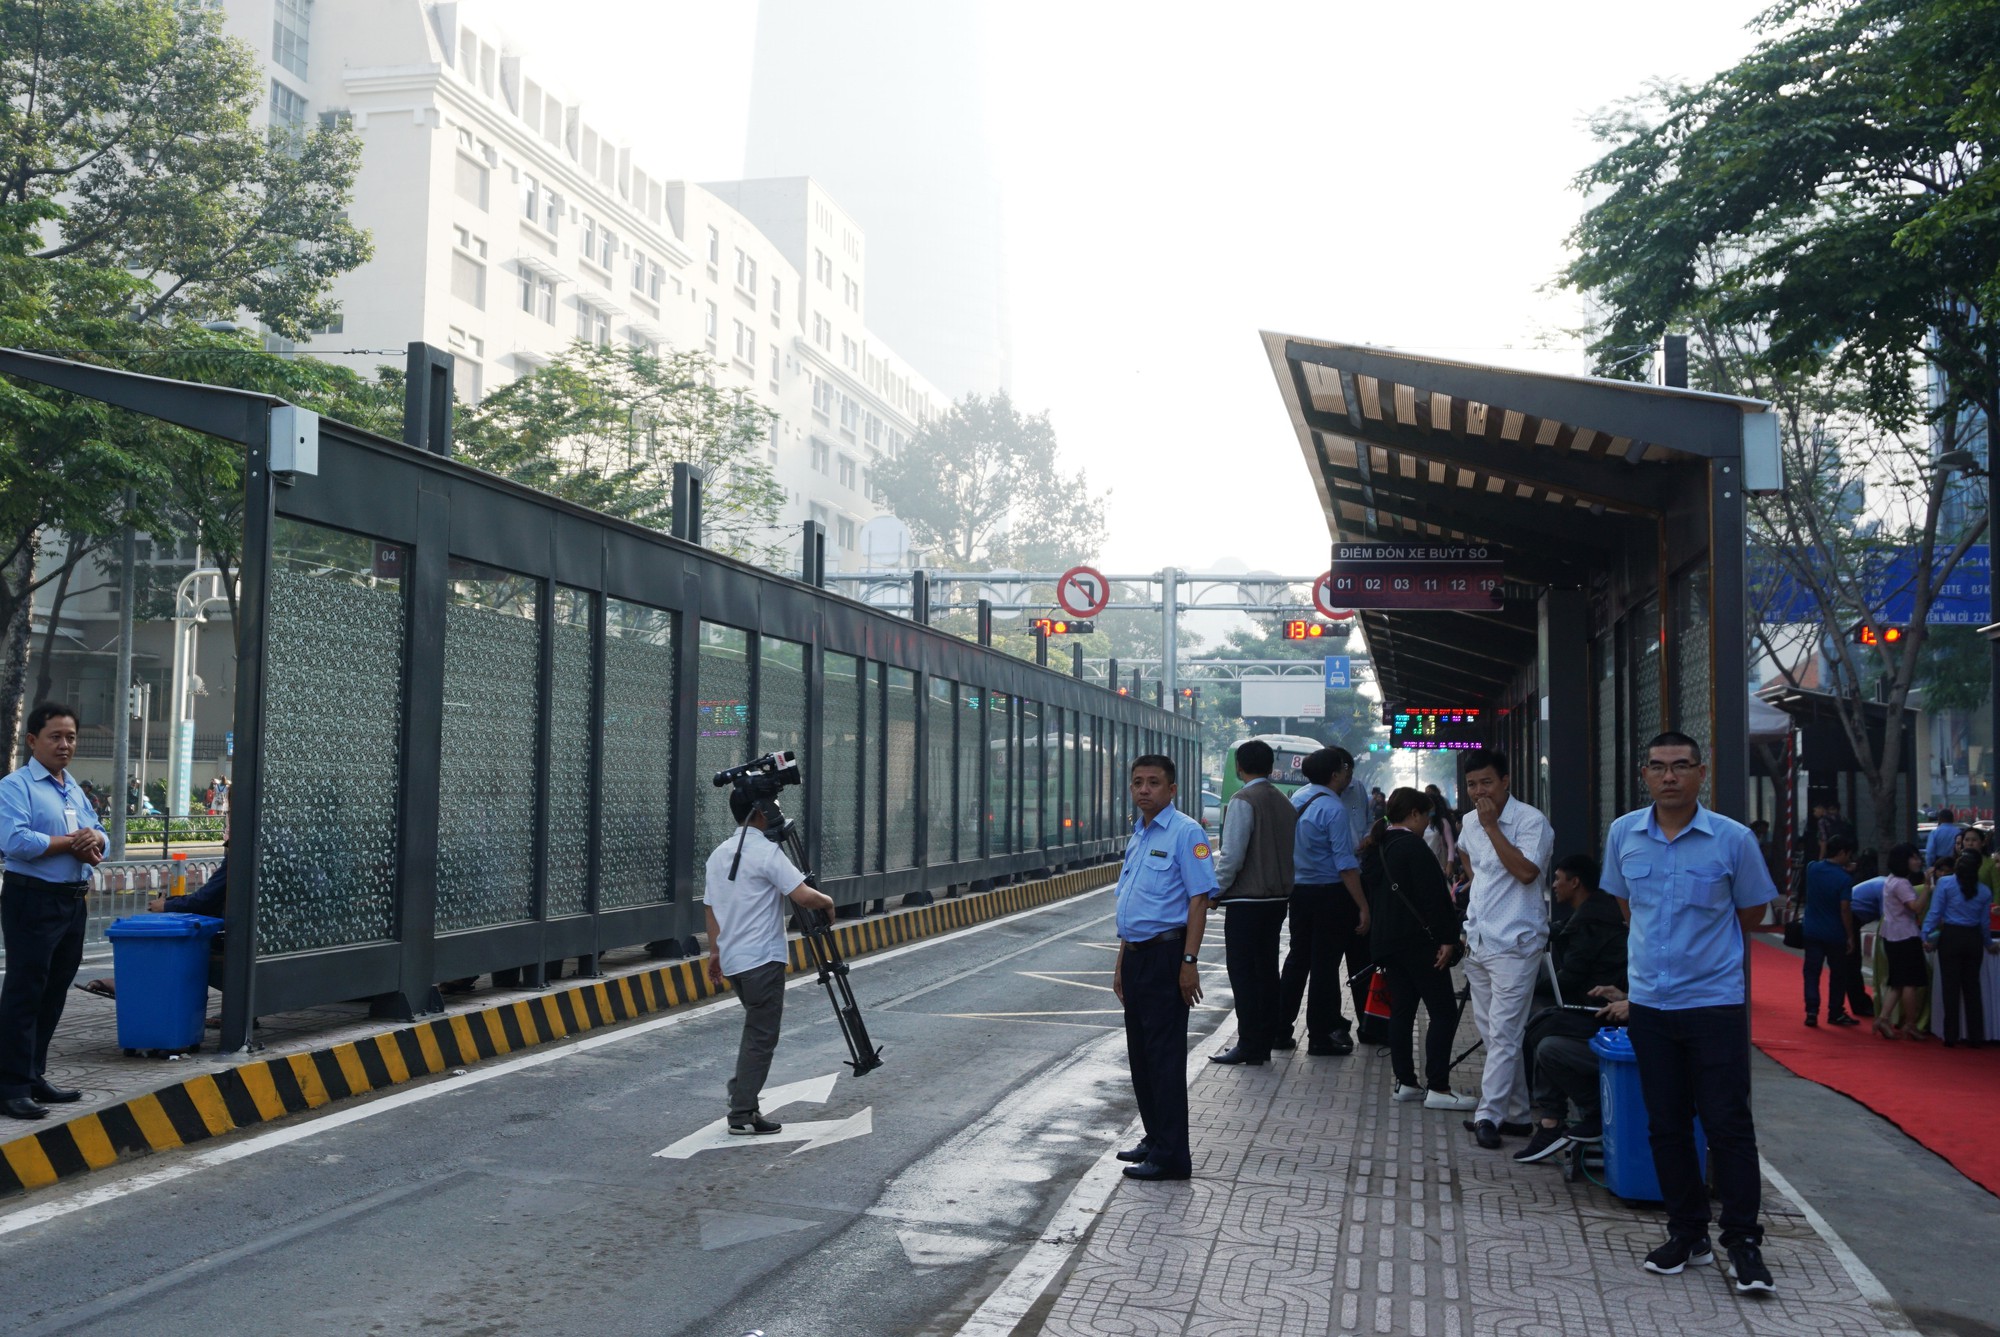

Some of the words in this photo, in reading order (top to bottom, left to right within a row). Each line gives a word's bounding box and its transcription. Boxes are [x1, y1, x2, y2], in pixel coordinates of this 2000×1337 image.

[381, 550, 396, 562] 04
[1408, 548, 1426, 559] XE
[1429, 545, 1465, 559] BUÝT
[1337, 578, 1351, 589] 01
[1365, 578, 1381, 590] 02
[1394, 578, 1410, 590] 03
[1424, 579, 1437, 591] 11
[1451, 579, 1466, 591] 12
[1480, 579, 1496, 592] 19
[1290, 621, 1305, 639] 13
